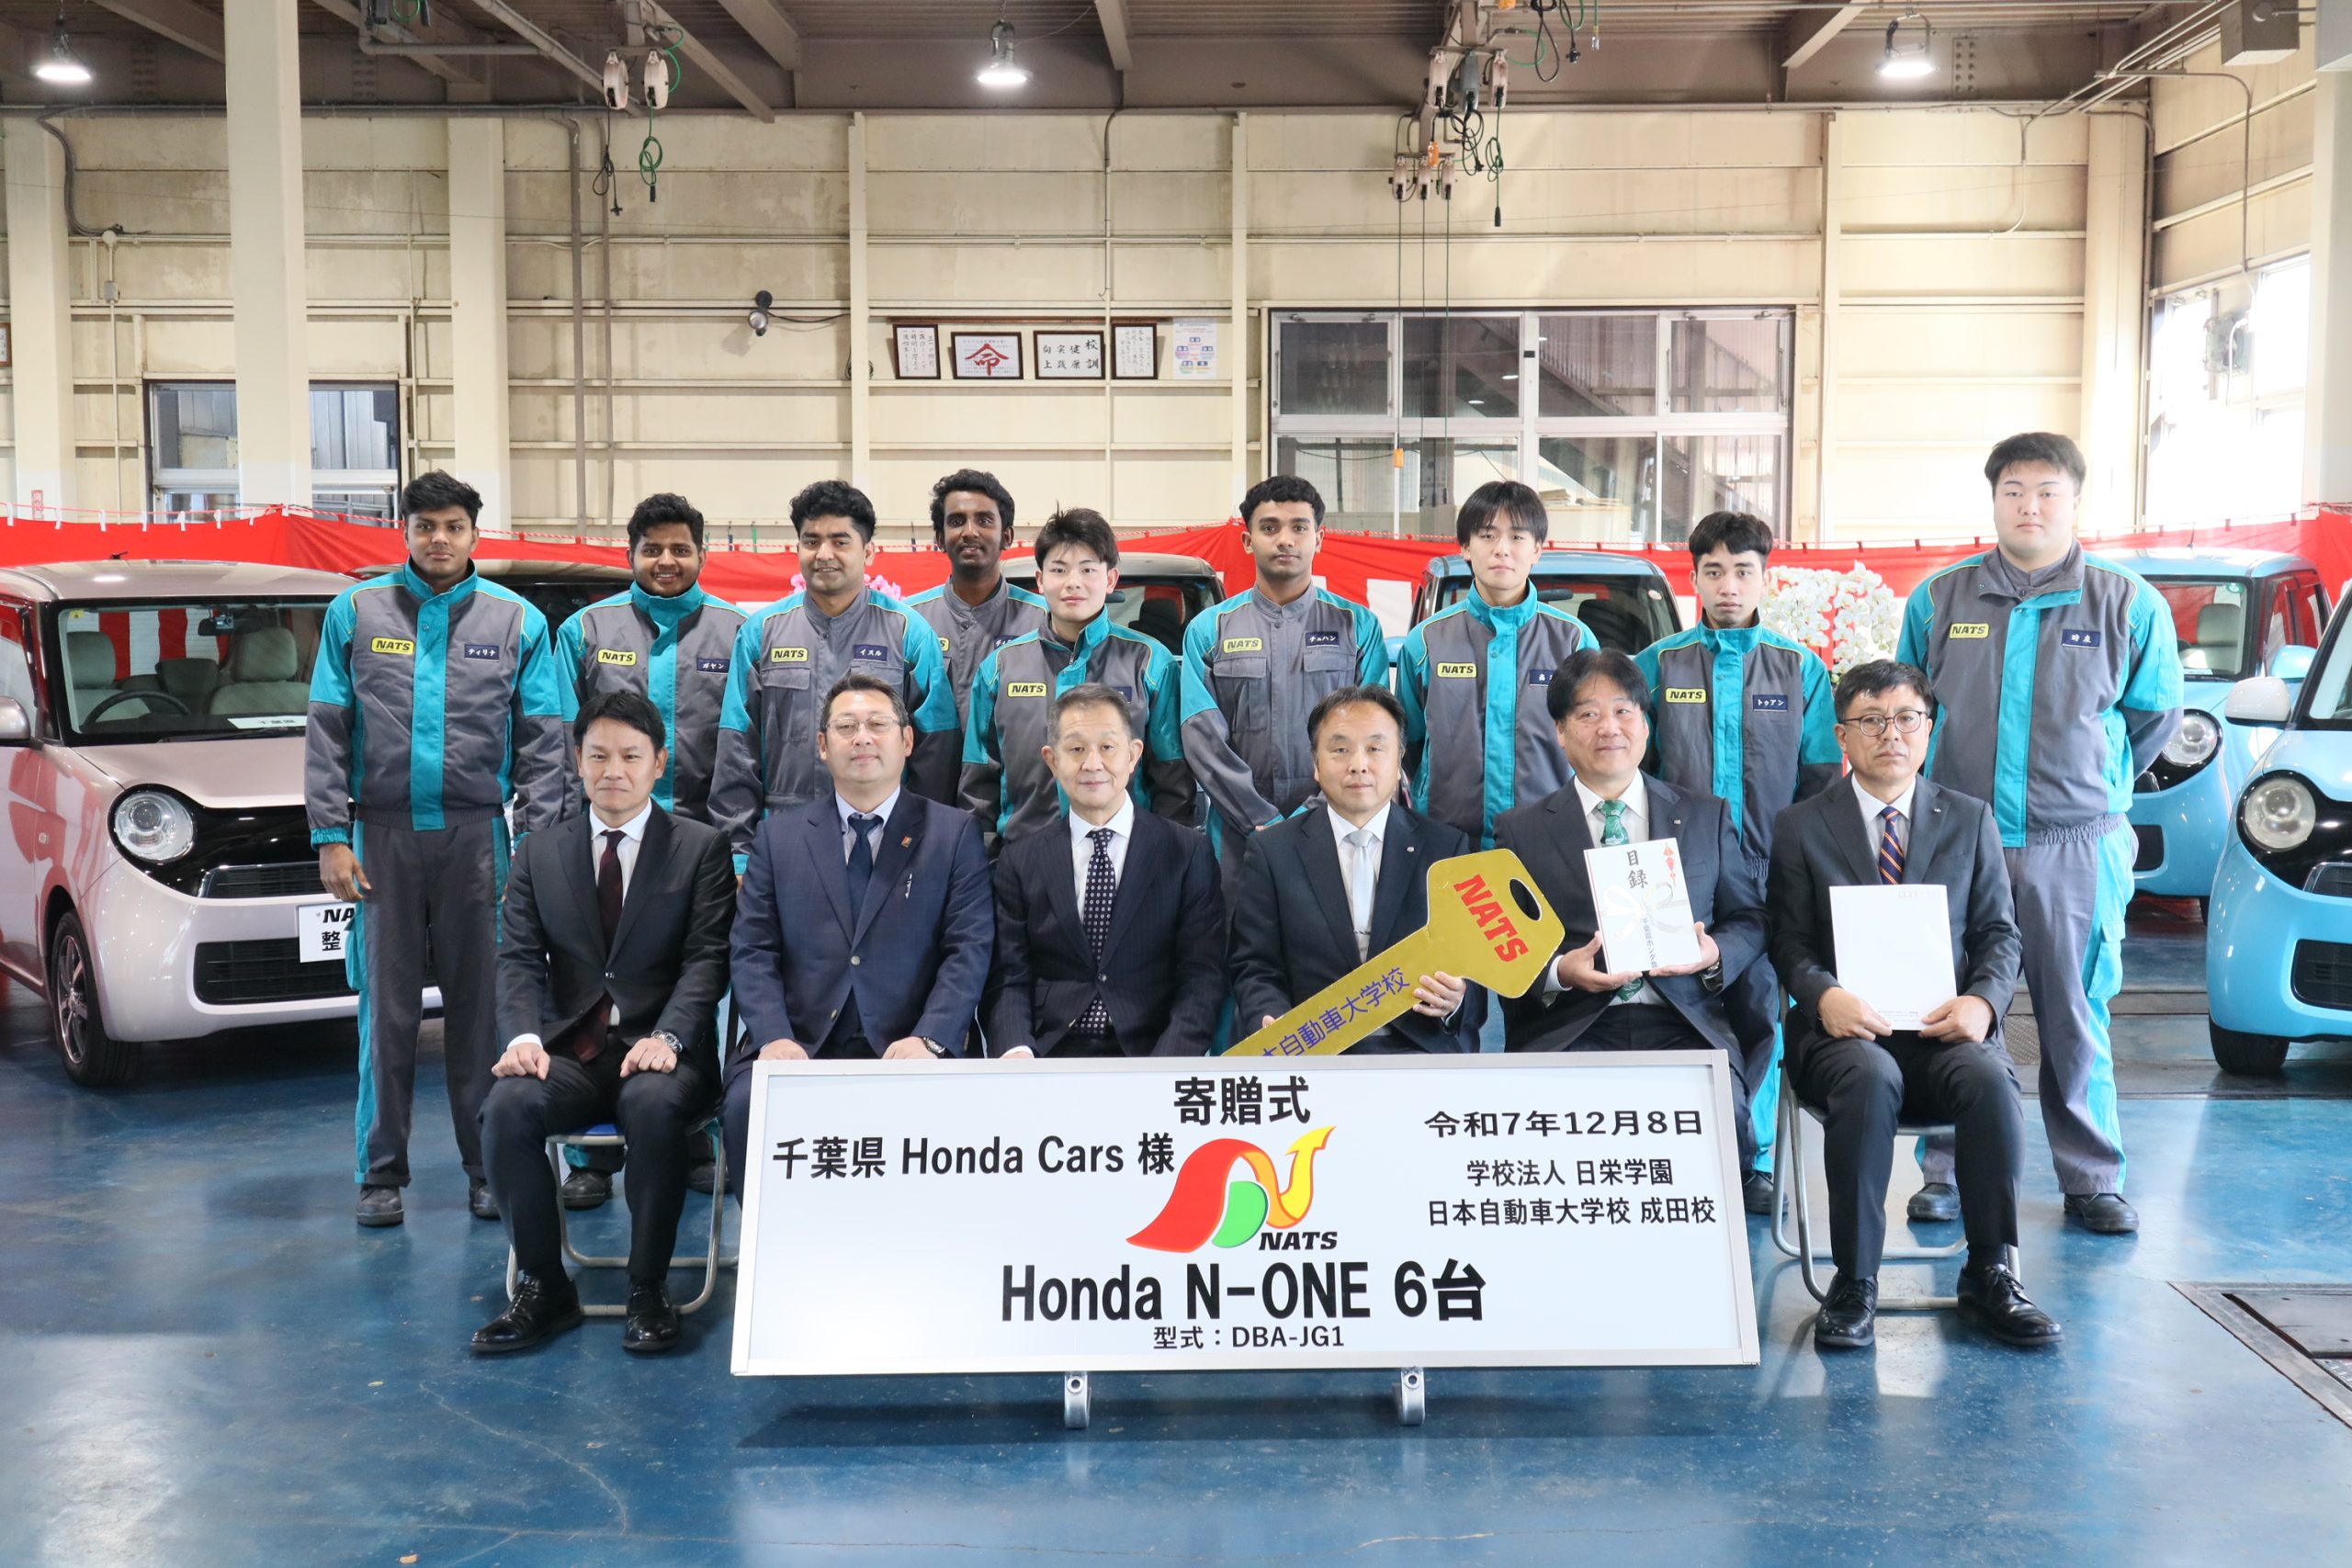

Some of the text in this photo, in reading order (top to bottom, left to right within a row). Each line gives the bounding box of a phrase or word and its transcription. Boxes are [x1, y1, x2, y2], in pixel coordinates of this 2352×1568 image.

[1043, 344, 1053, 369] 向上
[1085, 339, 1099, 369] 校訓
[1951, 626, 1985, 634] NATS
[376, 640, 411, 650] NATS
[468, 648, 496, 657] ティリナ
[774, 649, 805, 659] NATS
[1227, 639, 1259, 649] NATS
[602, 651, 633, 662] NATS
[1442, 665, 1474, 673] NATS
[1012, 684, 1045, 694] NATS
[1669, 691, 1702, 699] NATS
[1626, 850, 1648, 888] 目録
[1453, 874, 1529, 963] NATS
[322, 931, 341, 952] 整
[1173, 1075, 1311, 1126] 寄贈式
[1424, 1110, 1702, 1138] 令和7年12月8日
[773, 1132, 1175, 1179] 千葉県 Honda Cars 様
[1467, 1158, 1673, 1187] 学校法人 日栄学園
[1429, 1196, 1716, 1226] 日本自動車大学校 成田校
[1259, 1231, 1338, 1251] NATS
[1002, 1258, 1487, 1321] Honda N-ONE 6台
